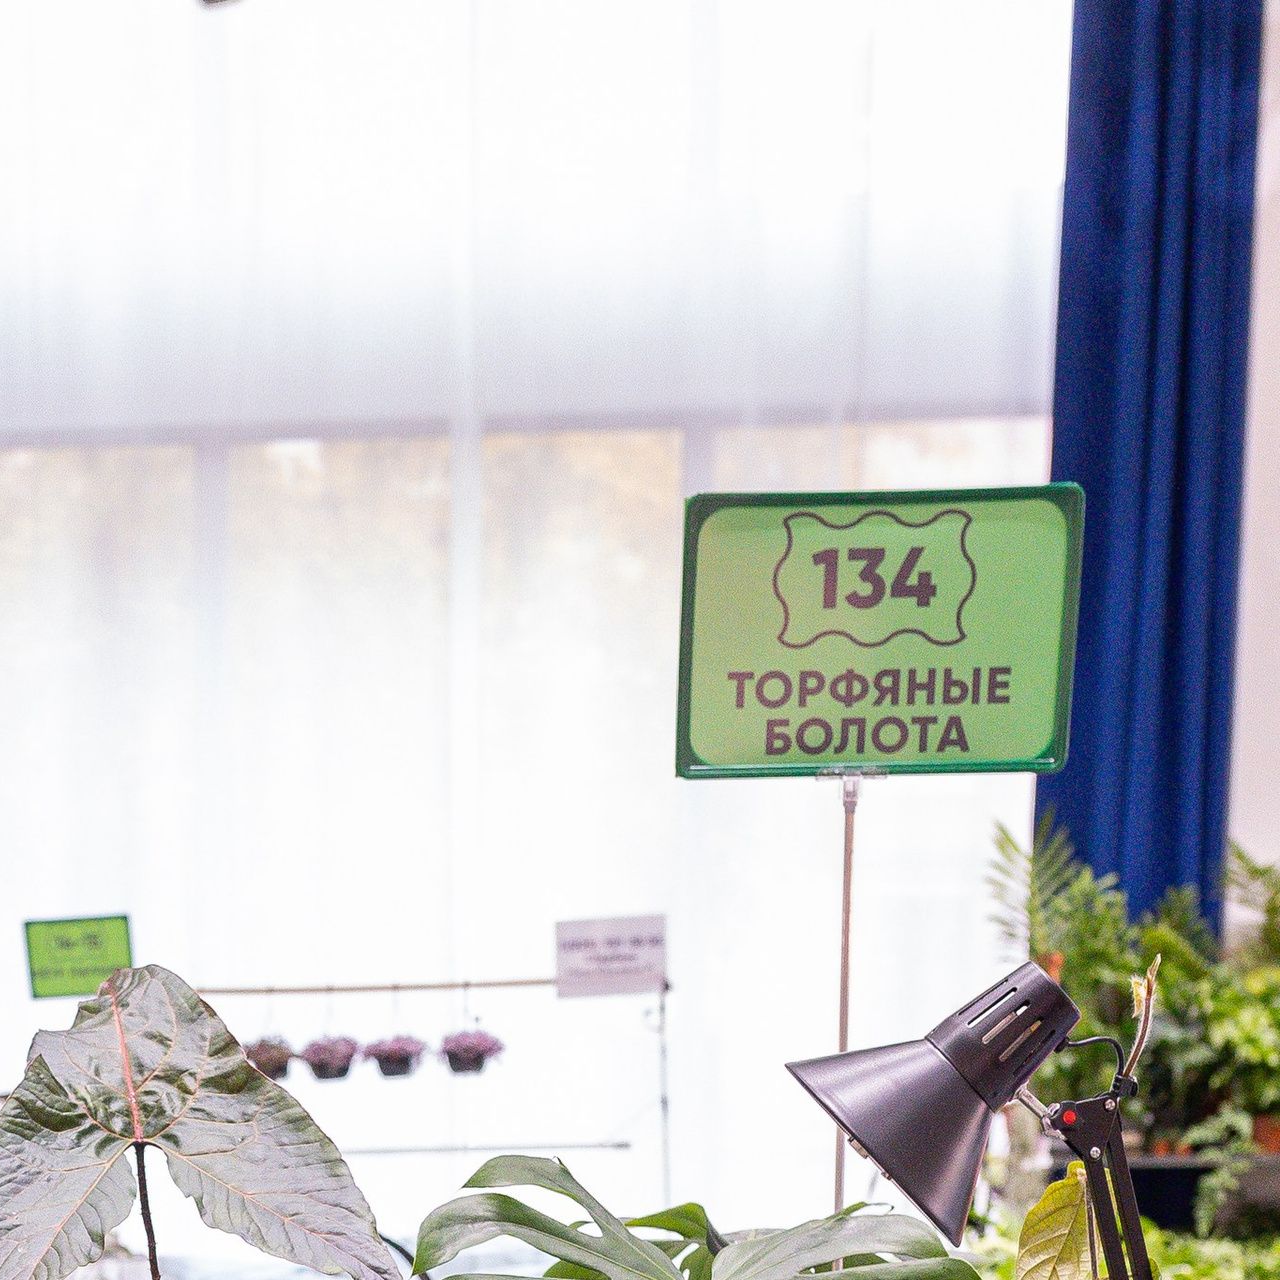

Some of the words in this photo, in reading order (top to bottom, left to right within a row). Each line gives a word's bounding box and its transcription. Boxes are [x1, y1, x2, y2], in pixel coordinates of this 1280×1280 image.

[812, 546, 937, 609] 134
[728, 666, 1012, 709] ТОРФЯНЫЕ
[765, 716, 969, 756] БОЛОТА
